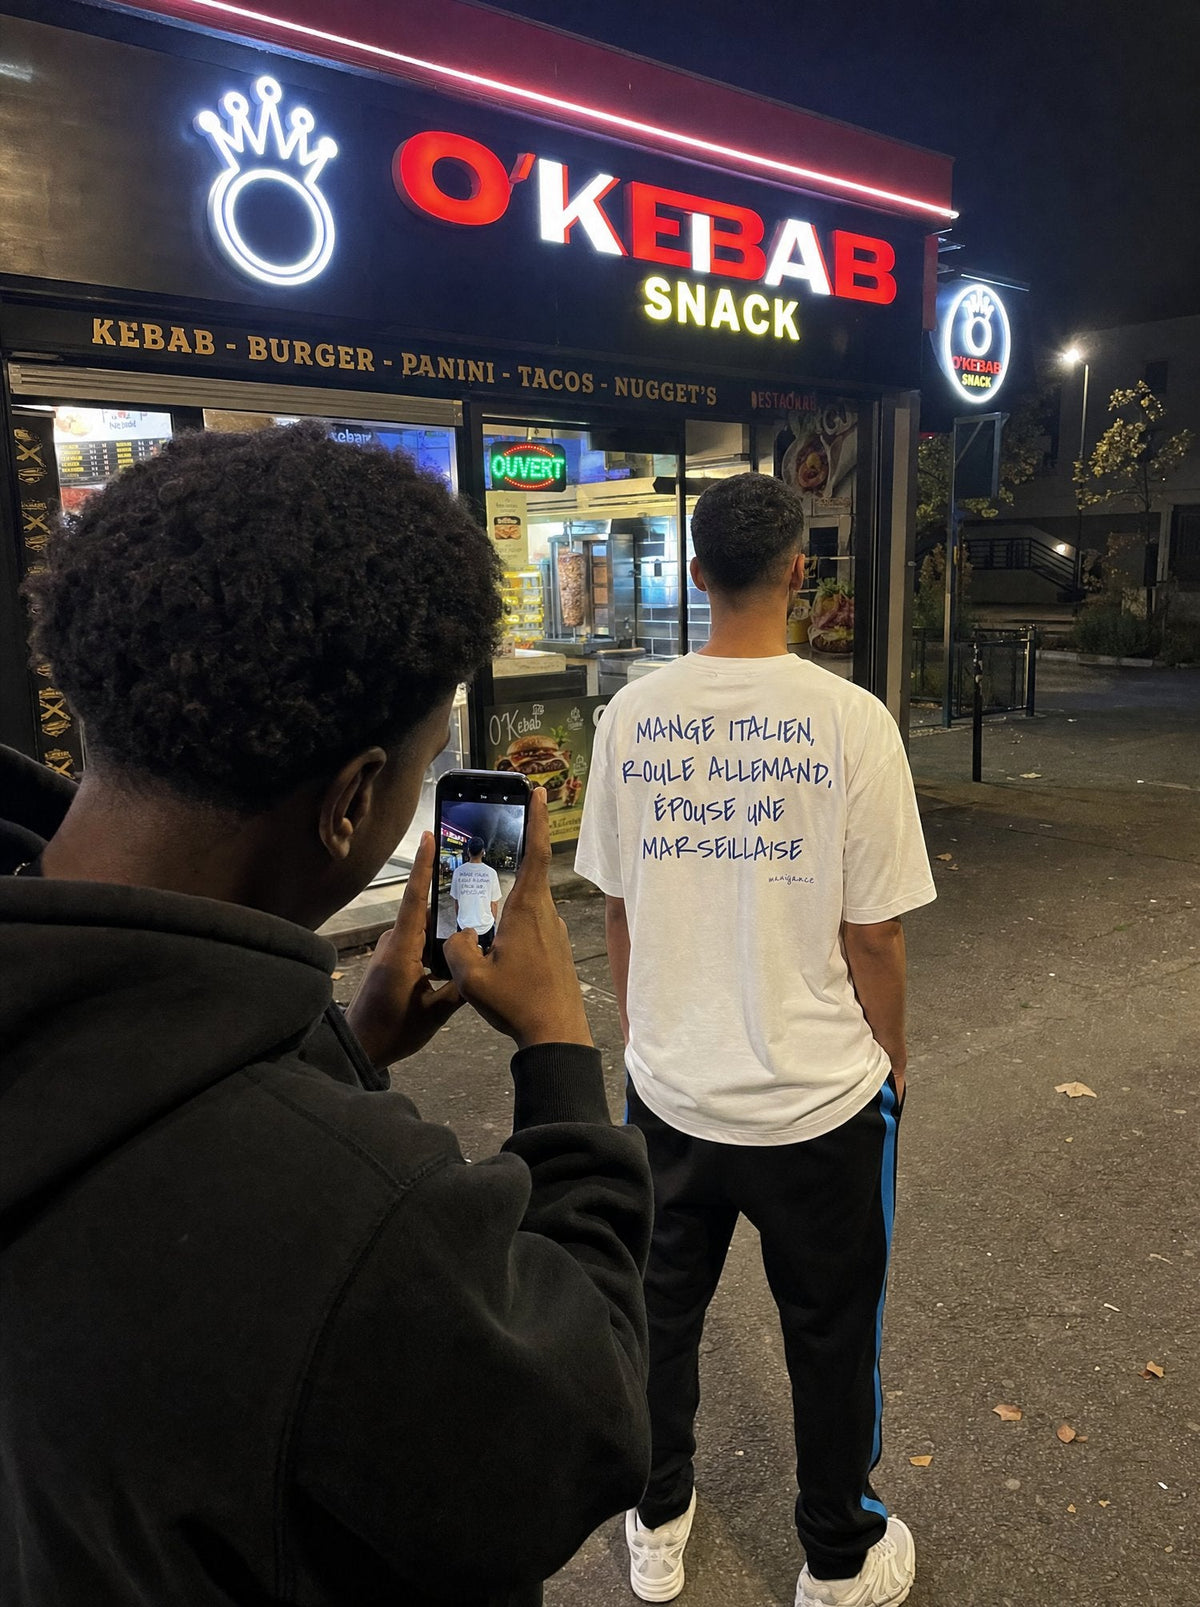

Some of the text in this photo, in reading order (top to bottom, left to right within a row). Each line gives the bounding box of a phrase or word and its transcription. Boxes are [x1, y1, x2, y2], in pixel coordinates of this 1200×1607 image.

[393, 130, 898, 306] O'KEBAB
[643, 275, 801, 342] SNACK
[91, 317, 216, 356] KEBAB
[246, 335, 376, 372] BURGER
[401, 351, 495, 384] PANINI
[517, 364, 595, 394] TACOS
[613, 375, 717, 406] NUGGET'S
[952, 356, 1002, 375] O'KEBAB
[961, 373, 992, 388] SNACK
[492, 455, 565, 479] OUVERT
[636, 714, 715, 745] MANGE
[729, 715, 815, 746] ITALIEN,
[622, 755, 833, 788] ROULE ALLEMAND,
[653, 793, 786, 826] ÉPOUSE UNE
[642, 836, 804, 861] MARSEILLAISE
